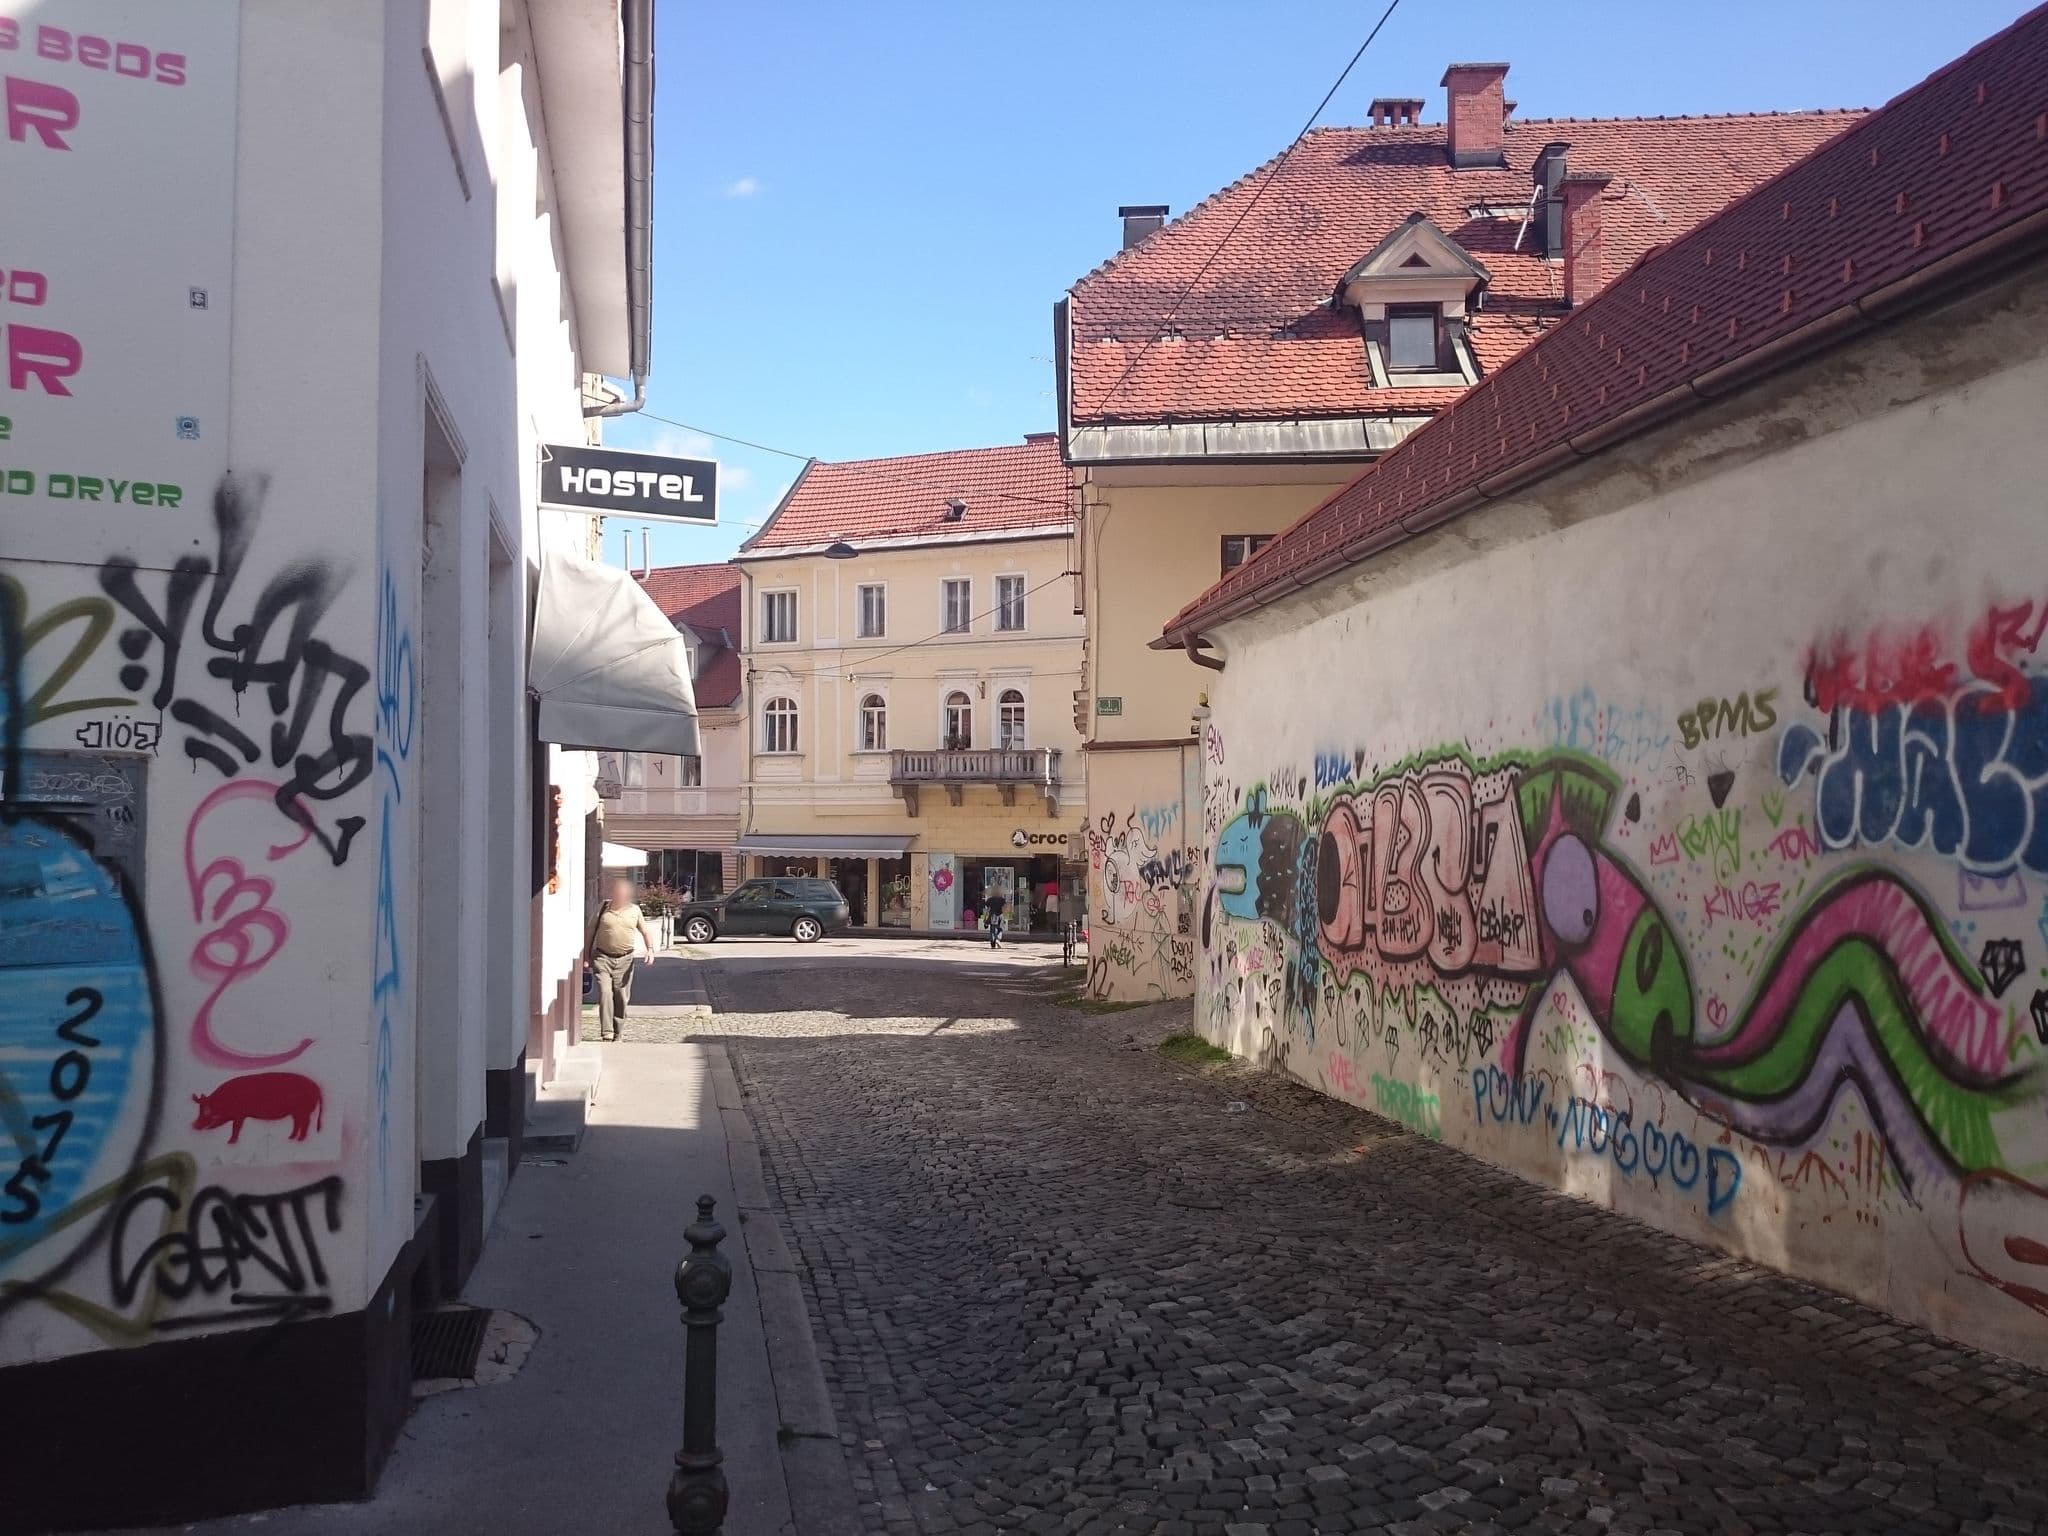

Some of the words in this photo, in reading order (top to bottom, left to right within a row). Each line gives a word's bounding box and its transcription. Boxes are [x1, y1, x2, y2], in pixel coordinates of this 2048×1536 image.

[0, 268, 48, 306] D
[0, 323, 83, 397] R
[0, 470, 35, 496] D
[1029, 835, 1068, 845] croc
